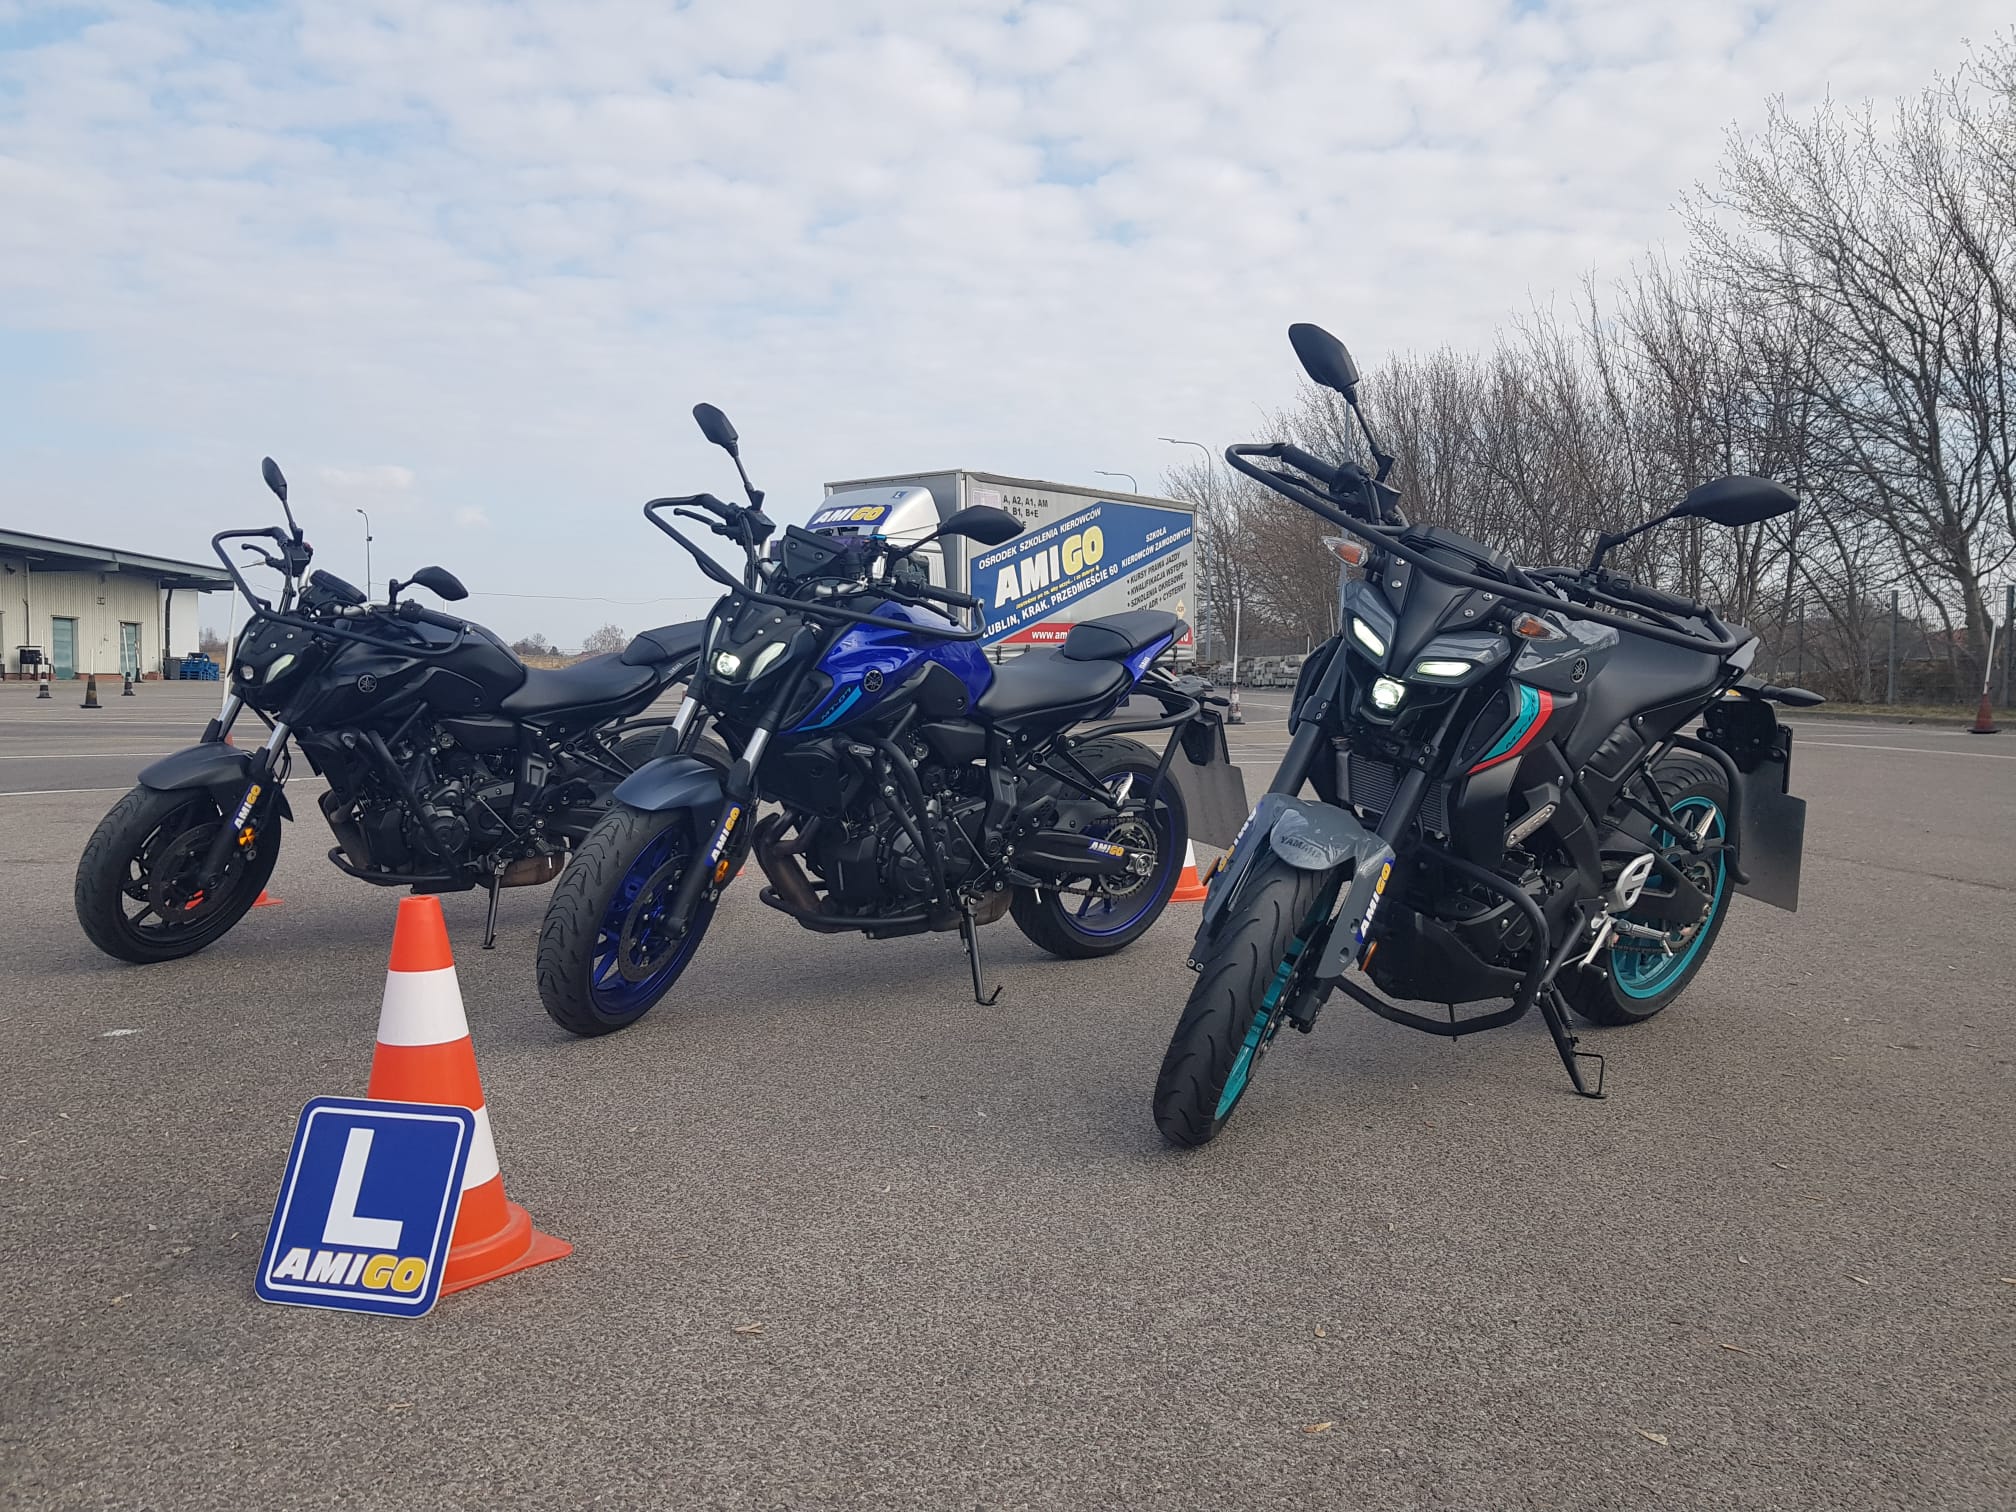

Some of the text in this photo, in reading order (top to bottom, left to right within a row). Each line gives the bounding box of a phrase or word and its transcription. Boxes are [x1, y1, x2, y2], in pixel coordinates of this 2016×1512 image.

[812, 506, 885, 524] AMIGO
[1012, 496, 1023, 506] A2,
[1038, 499, 1048, 508] AM
[1012, 507, 1023, 518] B1,
[1025, 509, 1039, 518] B+E
[978, 507, 1101, 570] OŚRODEK SZKOLENIA KIEROWCÓW
[1121, 526, 1191, 568] KIEROWCÓW ZAWODOWYCH
[1145, 526, 1167, 543] SZKOŁA
[995, 525, 1104, 609] AMIGO
[1021, 600, 1050, 619] KRAK.
[1051, 568, 1109, 606] PRZEDMIEŚCIE
[1109, 563, 1119, 576] 60
[234, 785, 261, 830] AMIGO
[711, 807, 741, 862] AMIGO
[1088, 841, 1125, 856] AMIGO
[1361, 863, 1391, 938] AMIGO
[321, 1127, 404, 1250] L
[272, 1247, 428, 1293] AMIGO
